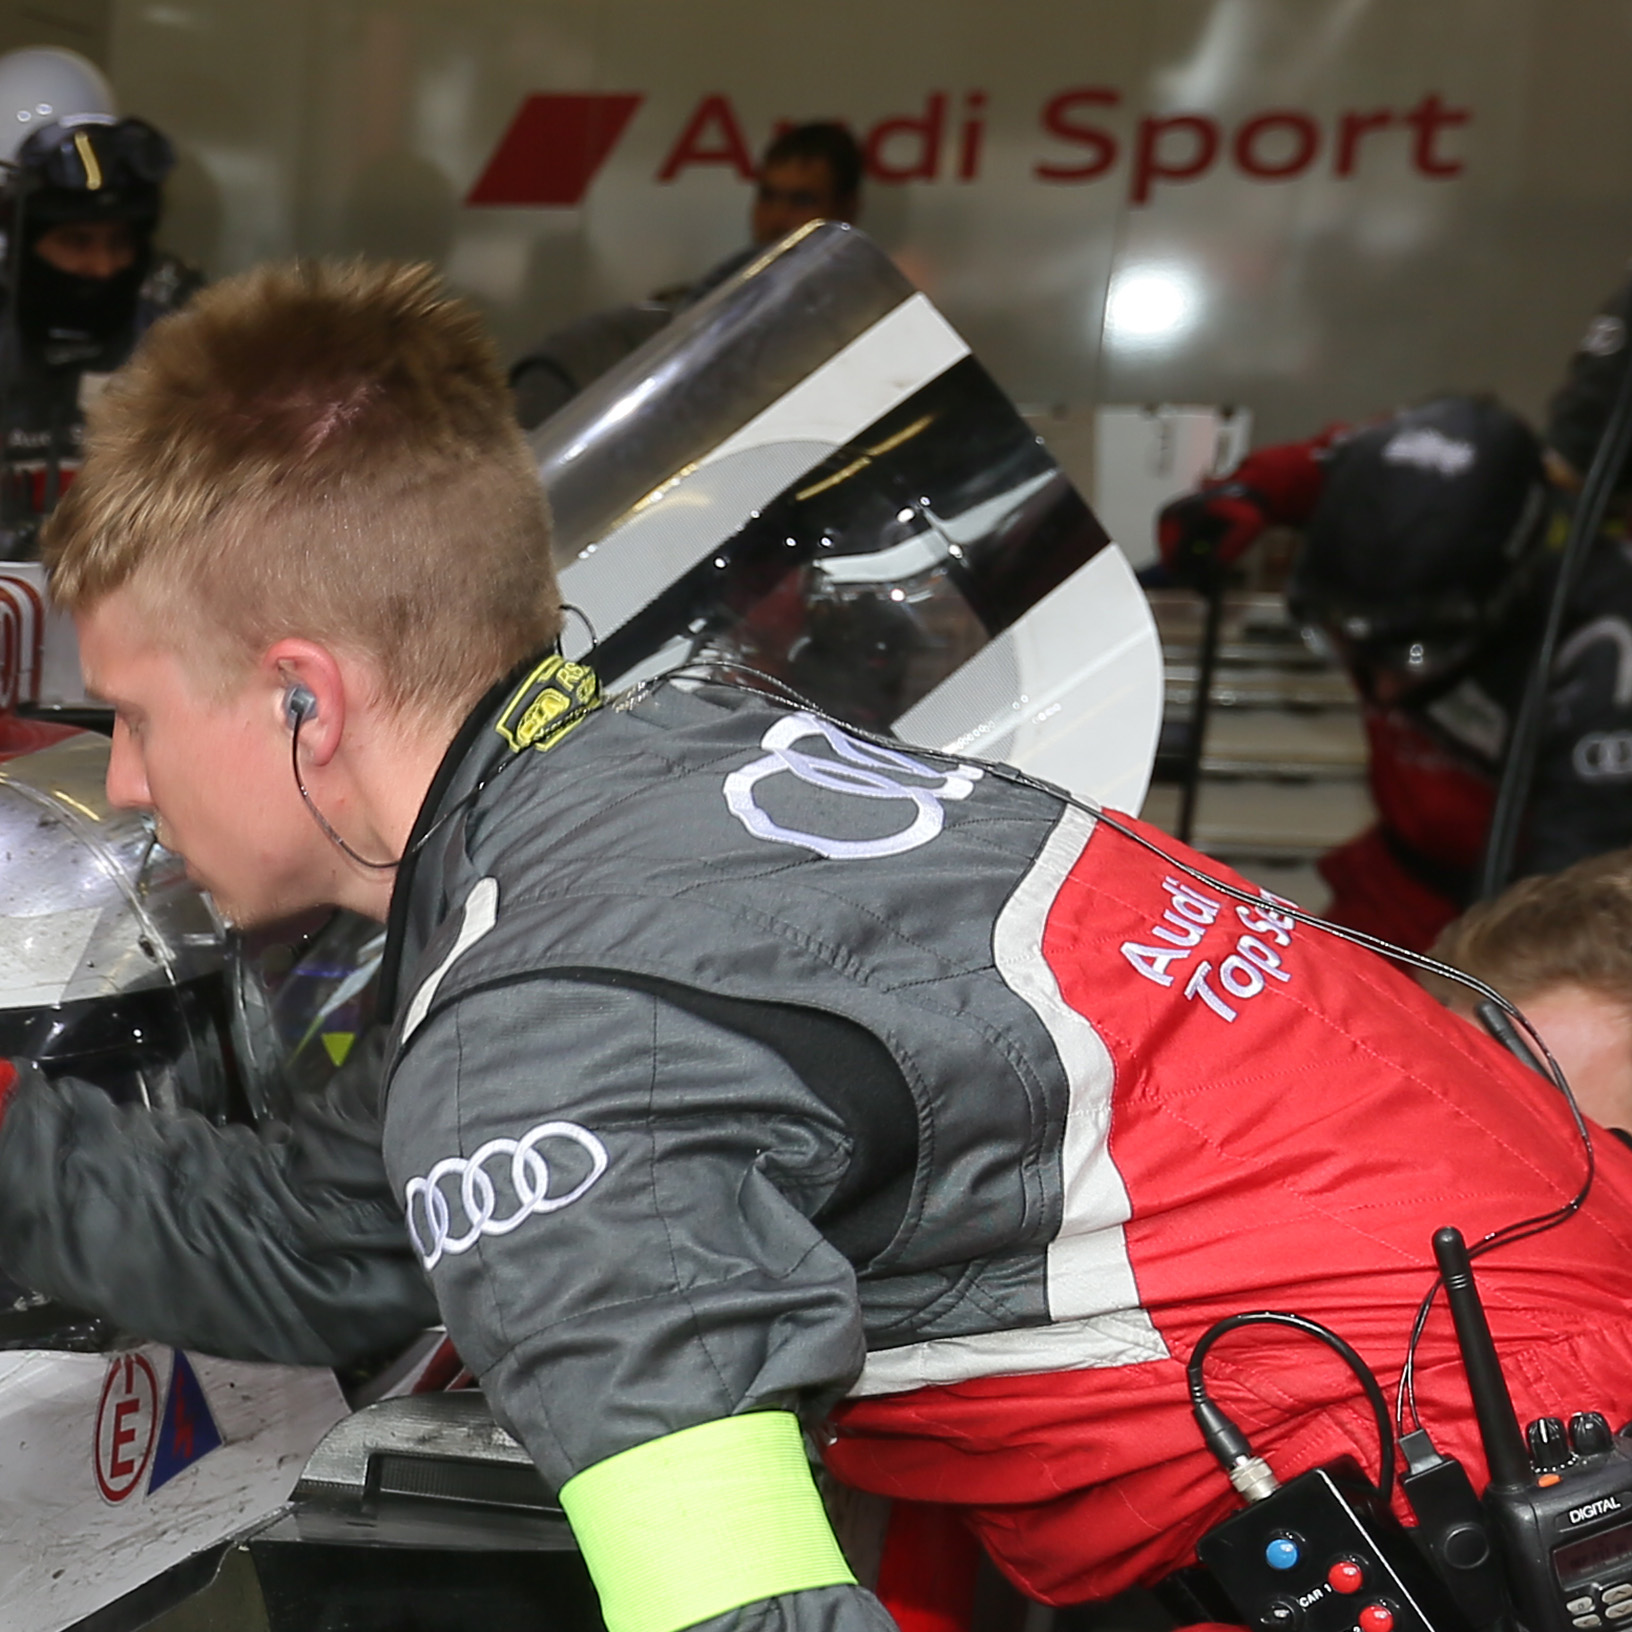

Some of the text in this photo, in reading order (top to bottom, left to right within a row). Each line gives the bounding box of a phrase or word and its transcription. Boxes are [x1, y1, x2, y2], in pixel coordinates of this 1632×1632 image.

[656, 88, 1471, 210] Adi Sport
[1120, 875, 1221, 987] Audi
[1184, 934, 1292, 1022] Top
[110, 1401, 141, 1479] E
[1568, 1496, 1623, 1526] DIGITAL
[1299, 1588, 1324, 1608] CAR
